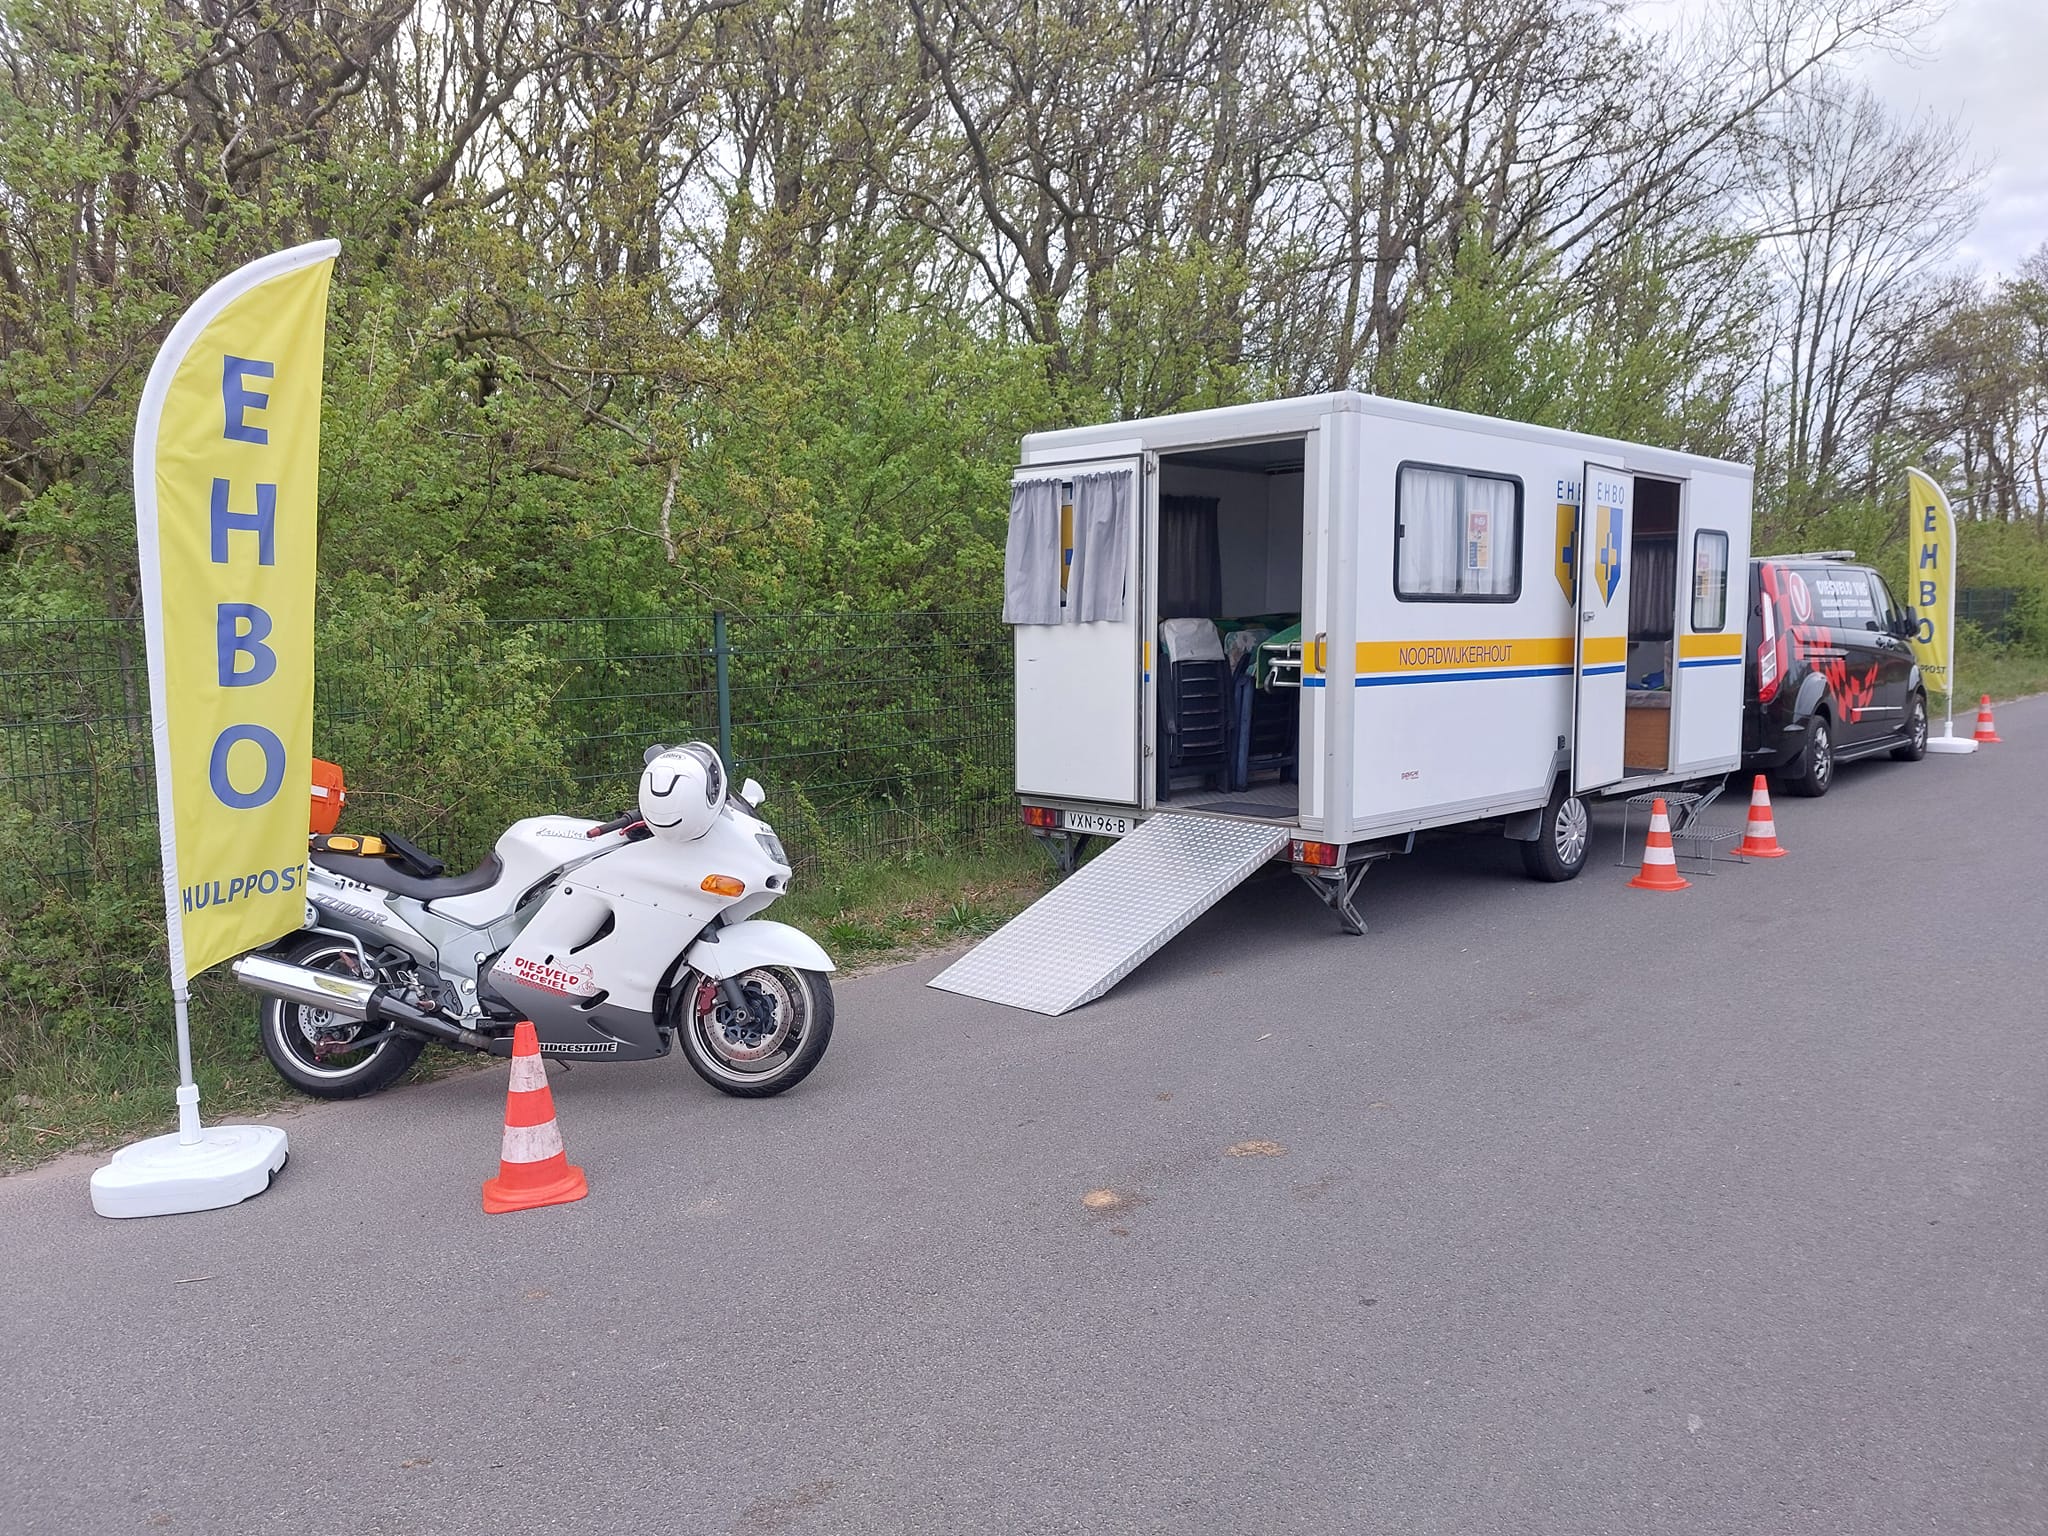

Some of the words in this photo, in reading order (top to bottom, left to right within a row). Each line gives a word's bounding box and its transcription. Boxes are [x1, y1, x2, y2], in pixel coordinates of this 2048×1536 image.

[1557, 480, 1581, 501] EH
[1597, 481, 1625, 505] EHBO
[208, 353, 286, 811] EHBO
[1918, 505, 1938, 644] EHBO
[1399, 645, 1512, 666] NOORDWIJKERHOUT
[1919, 664, 1946, 674] PPOST
[1069, 813, 1126, 833] VXN-96-B
[182, 864, 304, 915] HULPPOST
[514, 957, 579, 985] DIESVELD
[519, 969, 567, 990] MOBIEL
[540, 1042, 617, 1052] RIDGESTONE
